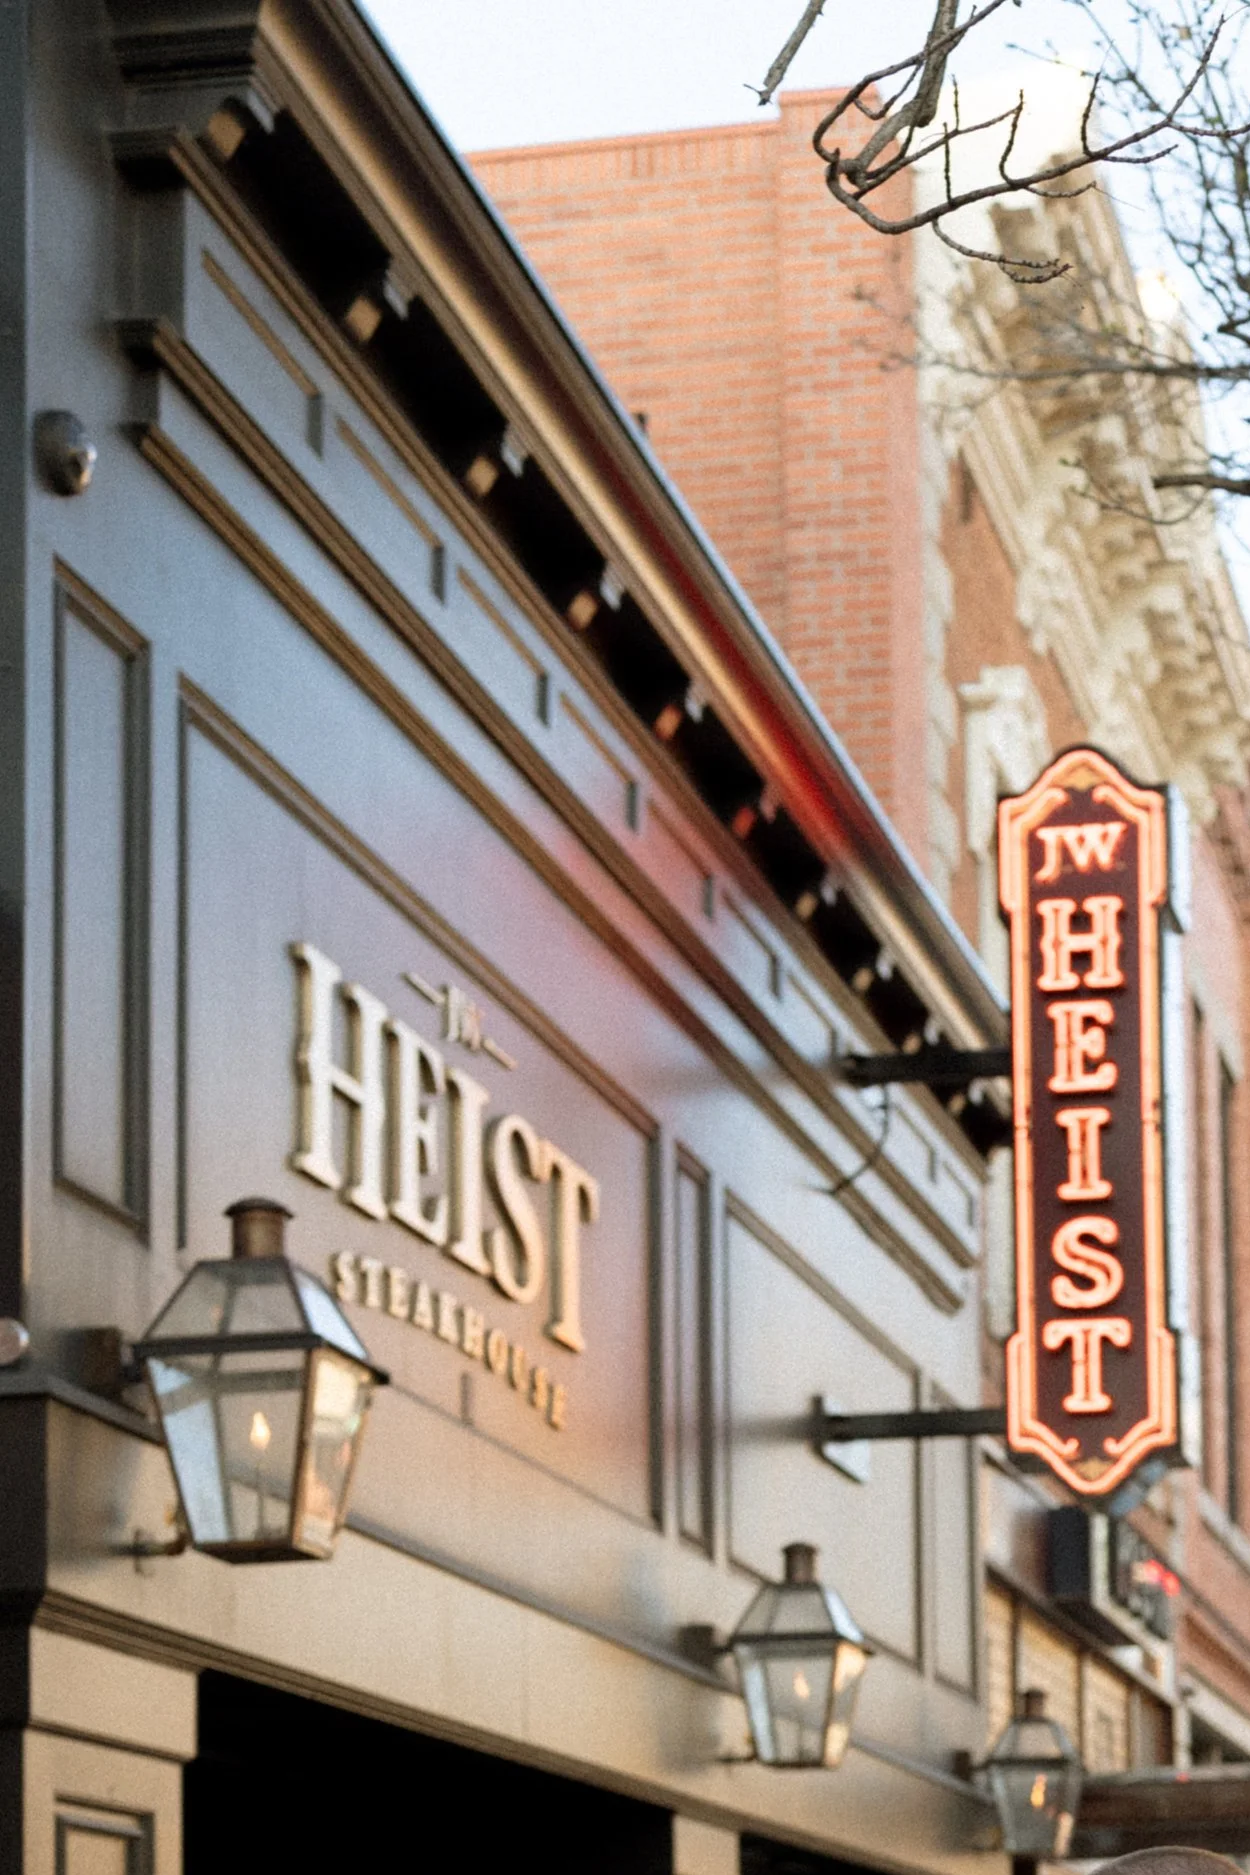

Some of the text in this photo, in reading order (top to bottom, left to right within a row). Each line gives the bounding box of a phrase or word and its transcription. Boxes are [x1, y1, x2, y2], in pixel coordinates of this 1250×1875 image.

[290, 941, 599, 1353] HEIST
[332, 1251, 567, 1430] STEAKHOUSE
[1036, 895, 1132, 1414] HEIST
